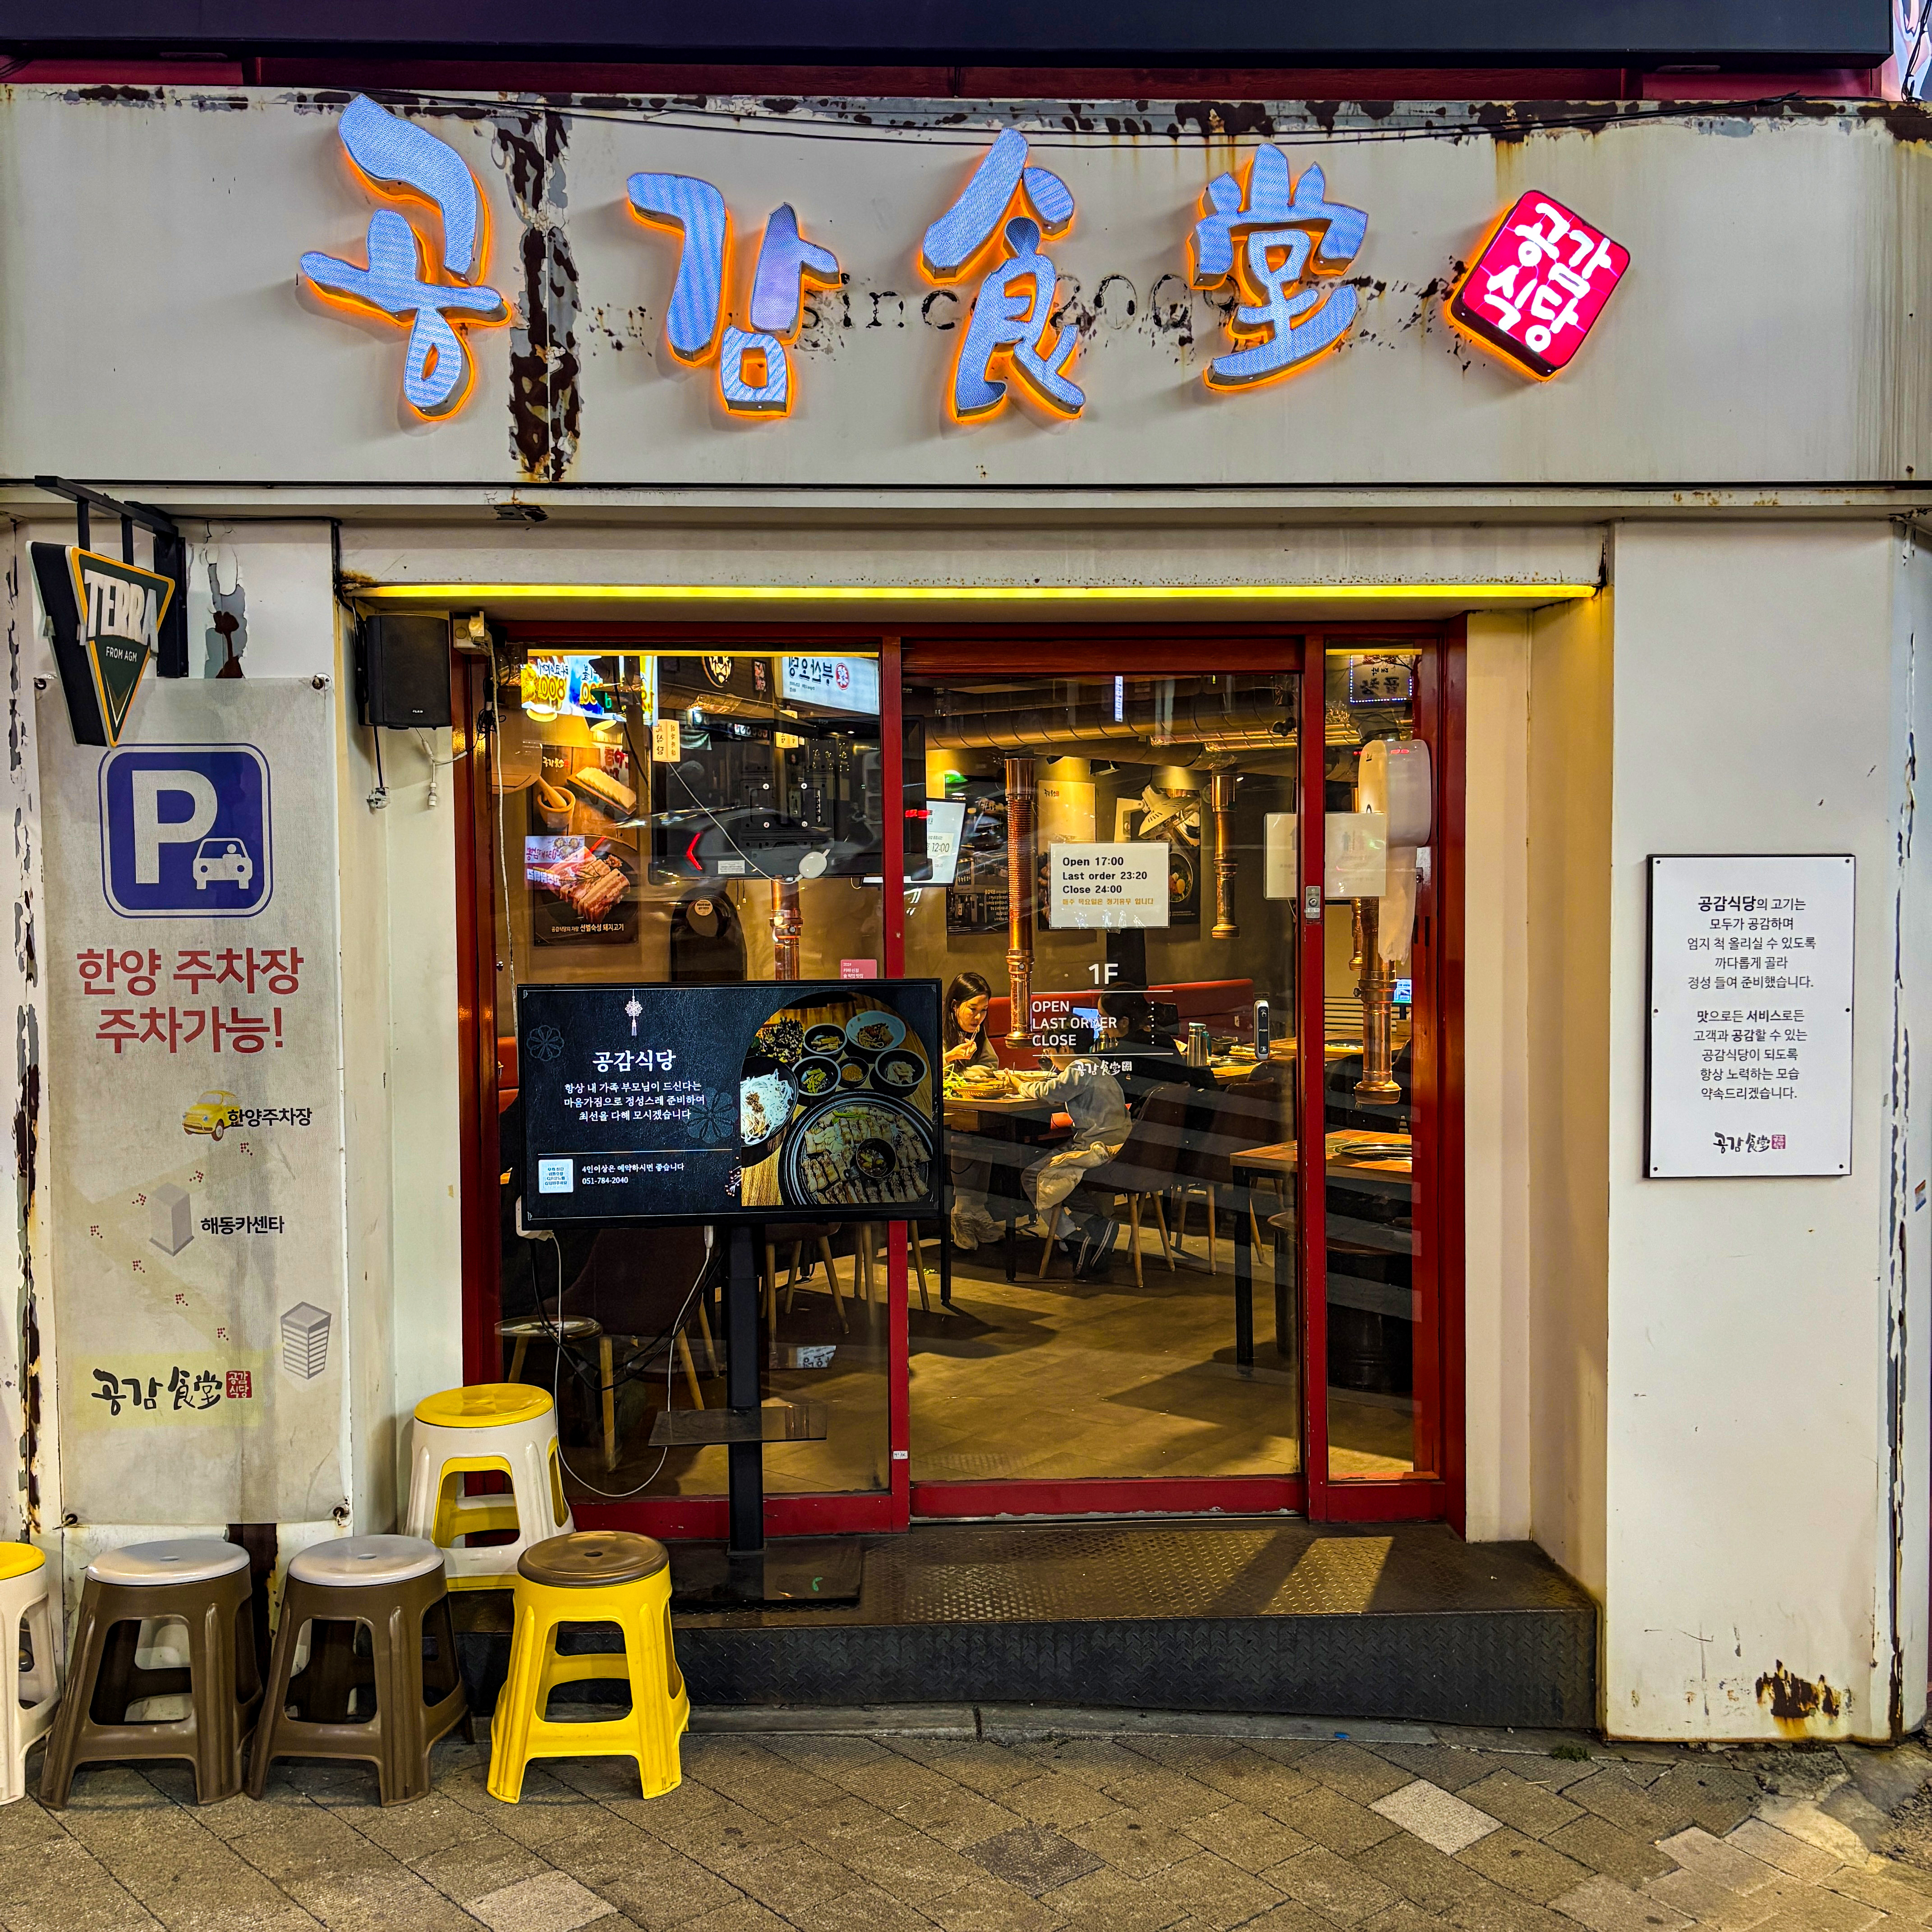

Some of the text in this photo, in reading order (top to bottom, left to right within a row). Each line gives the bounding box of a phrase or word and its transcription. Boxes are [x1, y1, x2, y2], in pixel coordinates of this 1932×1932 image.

[84, 569, 159, 653] TERRA
[106, 646, 137, 662] FROM AGM
[132, 770, 218, 884] P
[1063, 857, 1124, 867] Open 17:00
[1063, 871, 1147, 880] Last order 23:20
[1063, 885, 1122, 894] Close 24:00
[1698, 896, 1806, 911] 공감식당의 고기는
[1709, 917, 1794, 931] 모두가 공감하며
[1688, 937, 1817, 950] 엄지 척 올리실 수 있도록
[1715, 957, 1788, 970] 까다롭게 골라
[76, 948, 304, 996] 한양 주차장
[1088, 963, 1119, 985] 1F
[1688, 975, 1814, 989] 정성 들여 준비했습니다.
[1032, 1001, 1070, 1012] OPEN
[1697, 1009, 1805, 1023] 맛으로든 서비스로든
[96, 1007, 283, 1053] 주차가능!
[1032, 1017, 1117, 1030] LAST ORDER
[1032, 1035, 1076, 1046] CLOSE
[1693, 1029, 1808, 1043] 고객과 공감할 수 있는
[592, 1049, 676, 1072] 공감식당
[1702, 1048, 1798, 1062] 공감식당이 되도록
[1700, 1067, 1799, 1081] 항상 노력하는 모습
[564, 1081, 701, 1095] 항상 내 가족 부모님이 드신다는
[1701, 1087, 1797, 1100] 약속드리겠습니다.
[564, 1095, 705, 1108] 마음가짐으로 정성스레 준비하여
[227, 1108, 313, 1127] 한양주차장
[579, 1109, 691, 1122] 최선을 다해 모시겠습니다
[582, 1164, 616, 1173] 4인이상은
[655, 1162, 685, 1172] 좋습니다
[201, 1215, 285, 1235] 해동카센타
